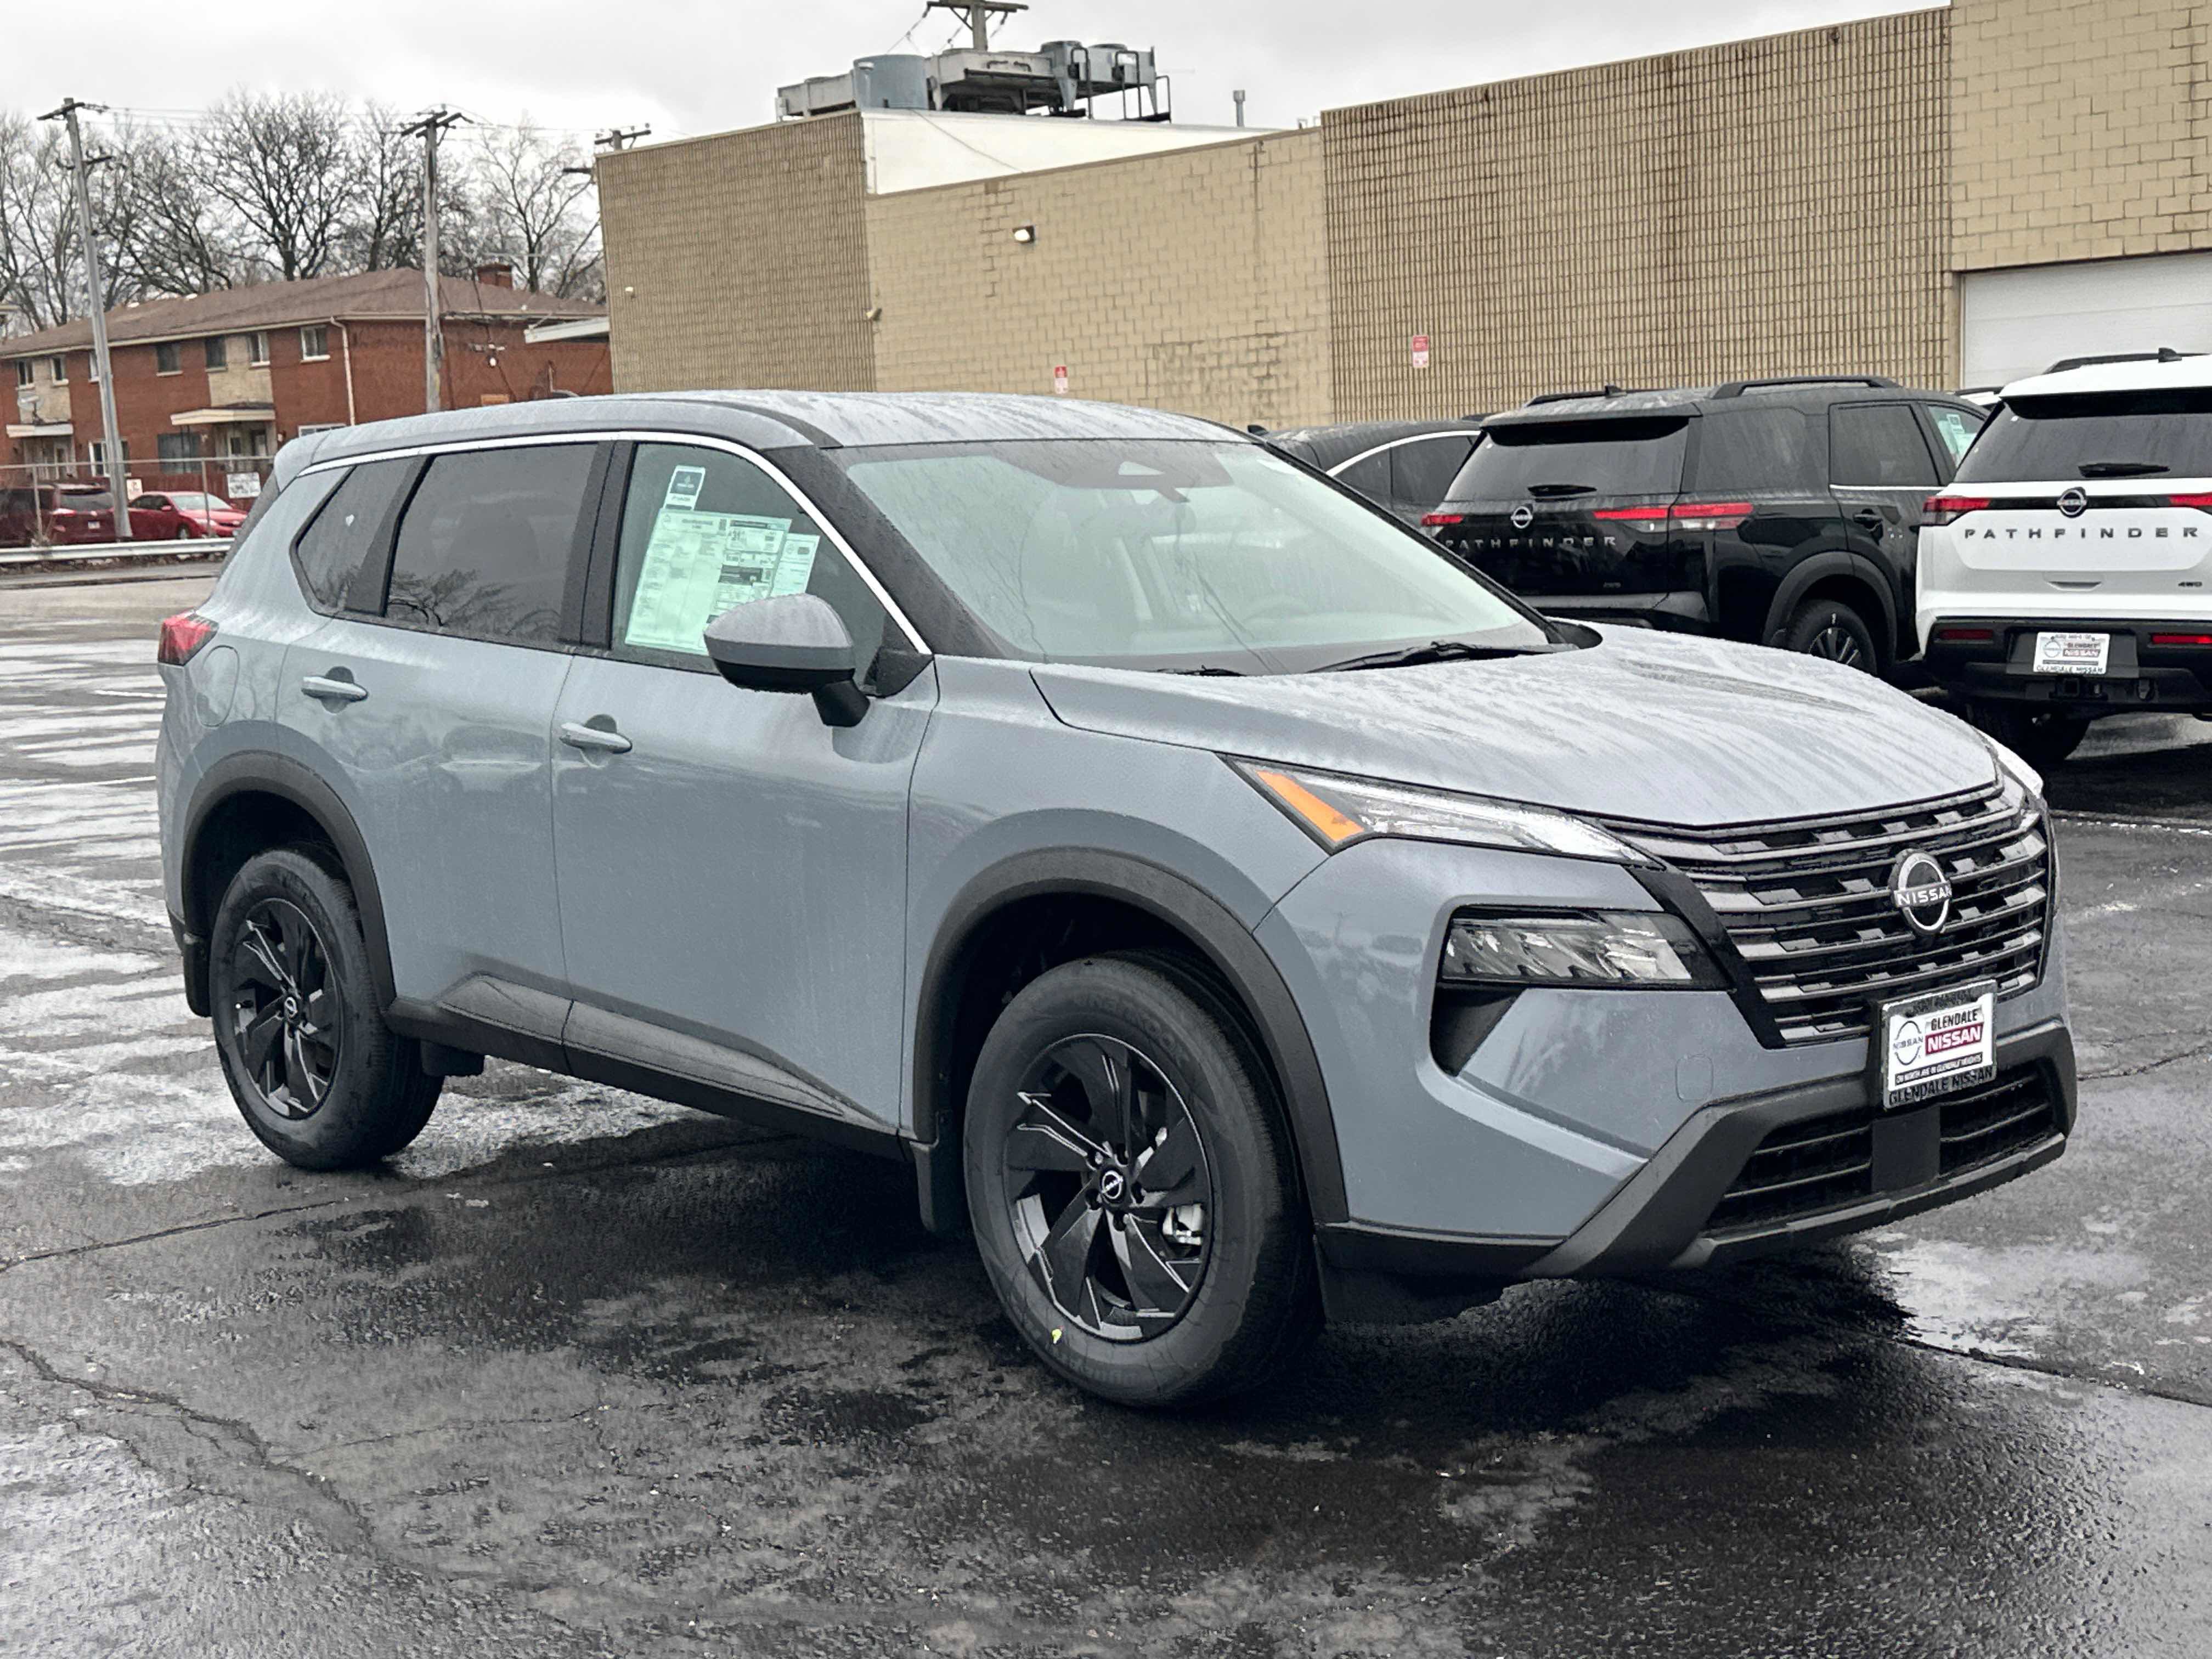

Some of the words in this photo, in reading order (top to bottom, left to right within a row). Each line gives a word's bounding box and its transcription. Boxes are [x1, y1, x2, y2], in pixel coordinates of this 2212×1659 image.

[1446, 537, 1616, 549] PATHFINDER
[1965, 527, 2198, 539] PATHFINDER
[1897, 885, 1952, 905] NISSAN
[1931, 1009, 1977, 1031] GLENDALE
[1927, 1025, 1982, 1052] NISSAN
[1889, 1077, 1948, 1105] GLENDALE
[1951, 1065, 1993, 1087] NISSAN
